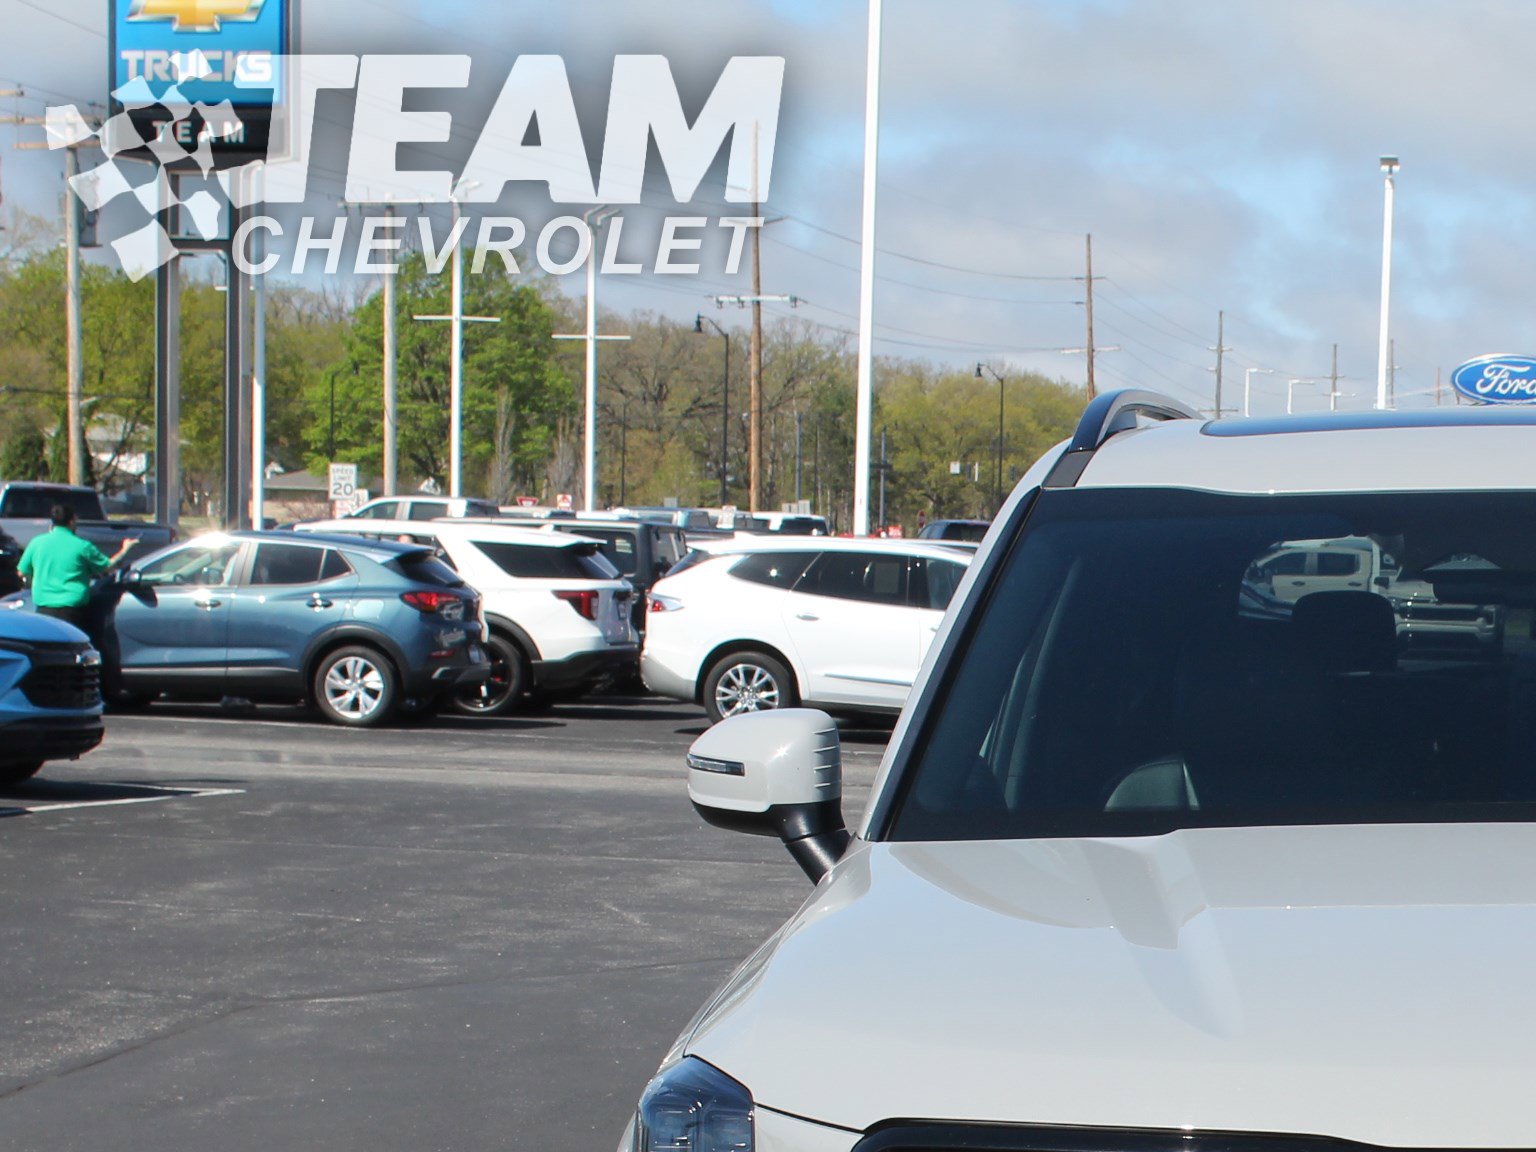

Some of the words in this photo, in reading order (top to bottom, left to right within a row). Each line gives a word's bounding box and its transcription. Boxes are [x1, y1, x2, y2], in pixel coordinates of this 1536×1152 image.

[121, 51, 273, 82] TRUCKS
[152, 121, 245, 143] TEAM
[333, 482, 353, 496] 20
